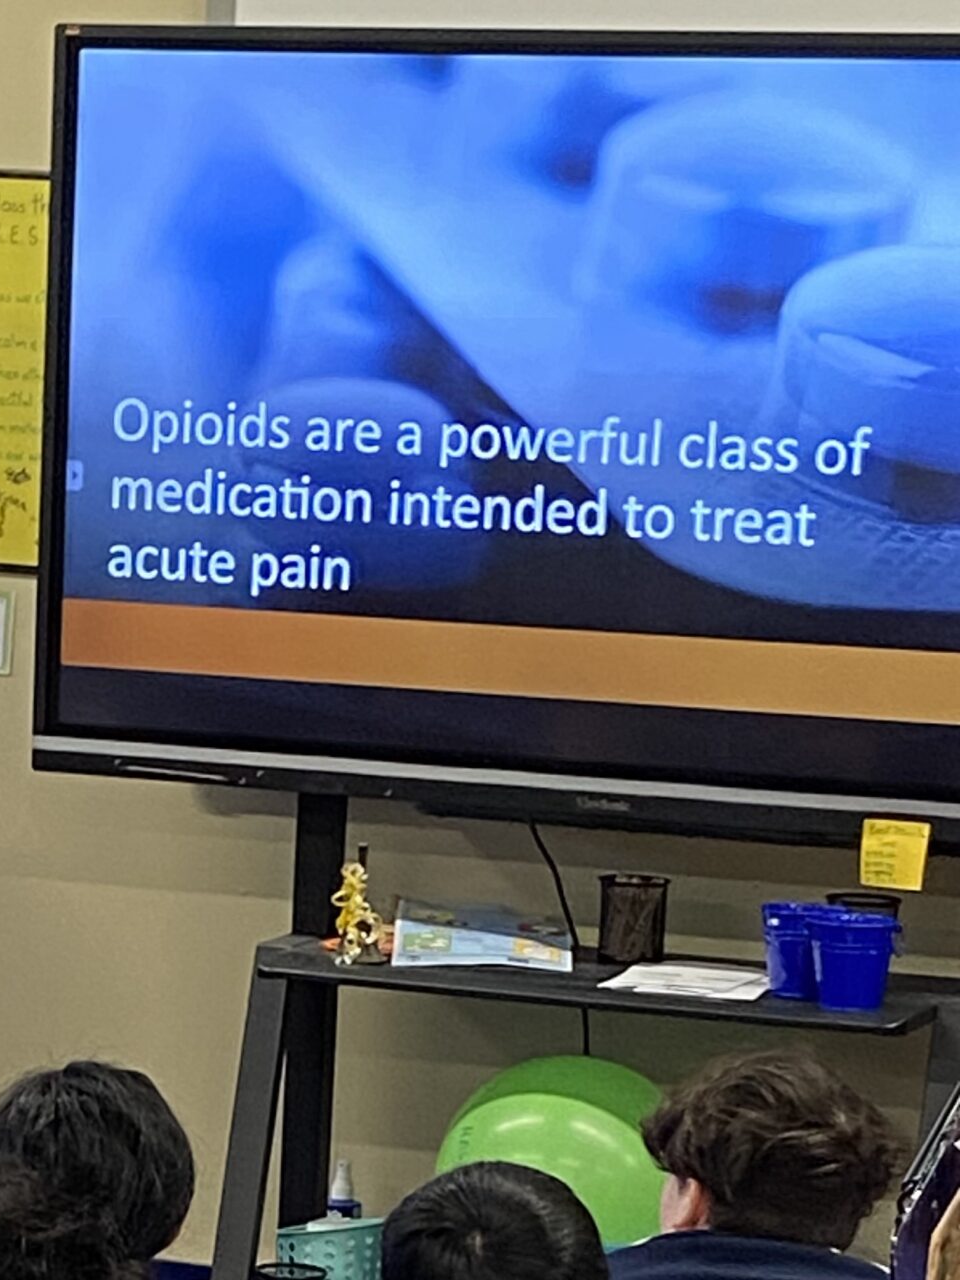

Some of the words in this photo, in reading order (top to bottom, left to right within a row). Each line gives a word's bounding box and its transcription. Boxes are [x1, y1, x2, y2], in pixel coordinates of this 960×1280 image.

[113, 397, 291, 453] Opioids
[304, 415, 382, 454] are
[396, 420, 422, 456] a
[439, 416, 663, 469] powerful
[678, 420, 800, 474] class
[814, 426, 873, 477] of
[111, 468, 372, 524] medication
[388, 479, 608, 537] intended
[623, 496, 676, 541] to
[690, 499, 817, 548] treat
[107, 542, 236, 585] acute
[250, 544, 352, 597] pain
